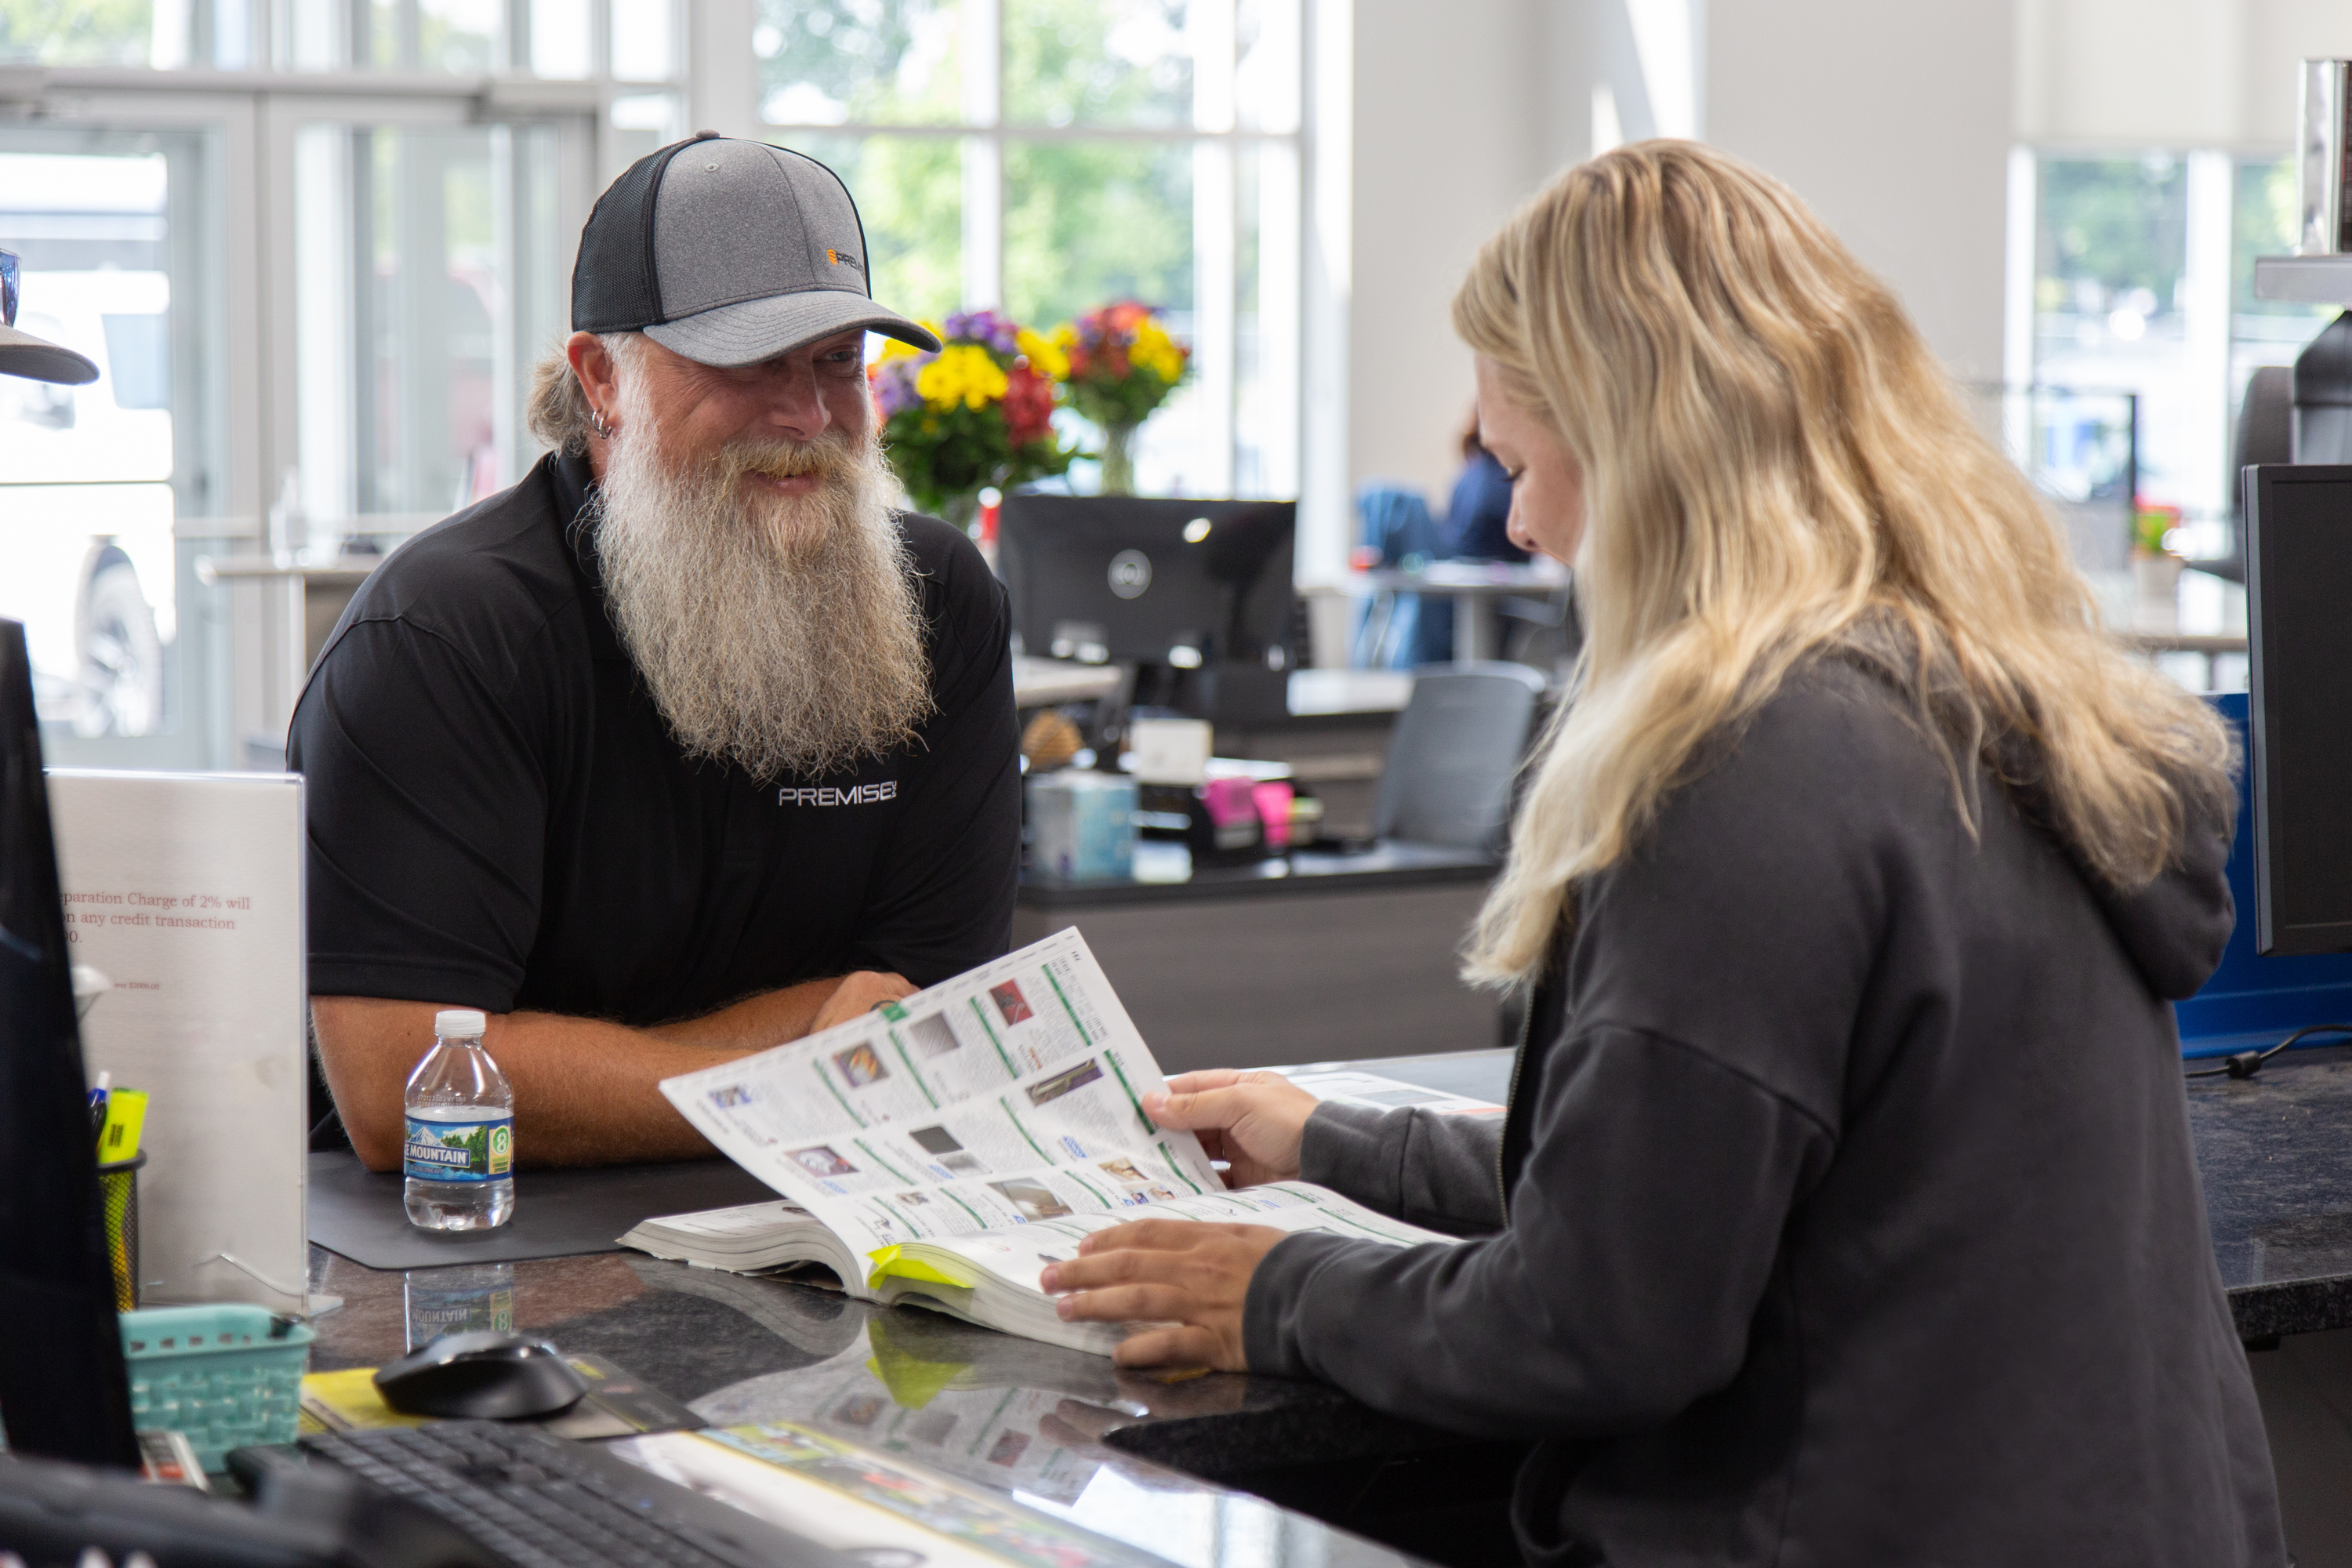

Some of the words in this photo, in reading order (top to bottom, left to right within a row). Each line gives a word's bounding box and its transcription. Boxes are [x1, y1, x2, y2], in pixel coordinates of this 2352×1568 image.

[779, 781, 892, 806] PREMISE
[128, 892, 176, 909] Charge
[182, 895, 195, 907] of
[199, 895, 222, 909] 2%
[226, 898, 251, 910] will
[81, 914, 105, 927] any
[111, 913, 151, 926] credit
[155, 915, 236, 930] transaction
[410, 1145, 466, 1164] MOUNTAIN
